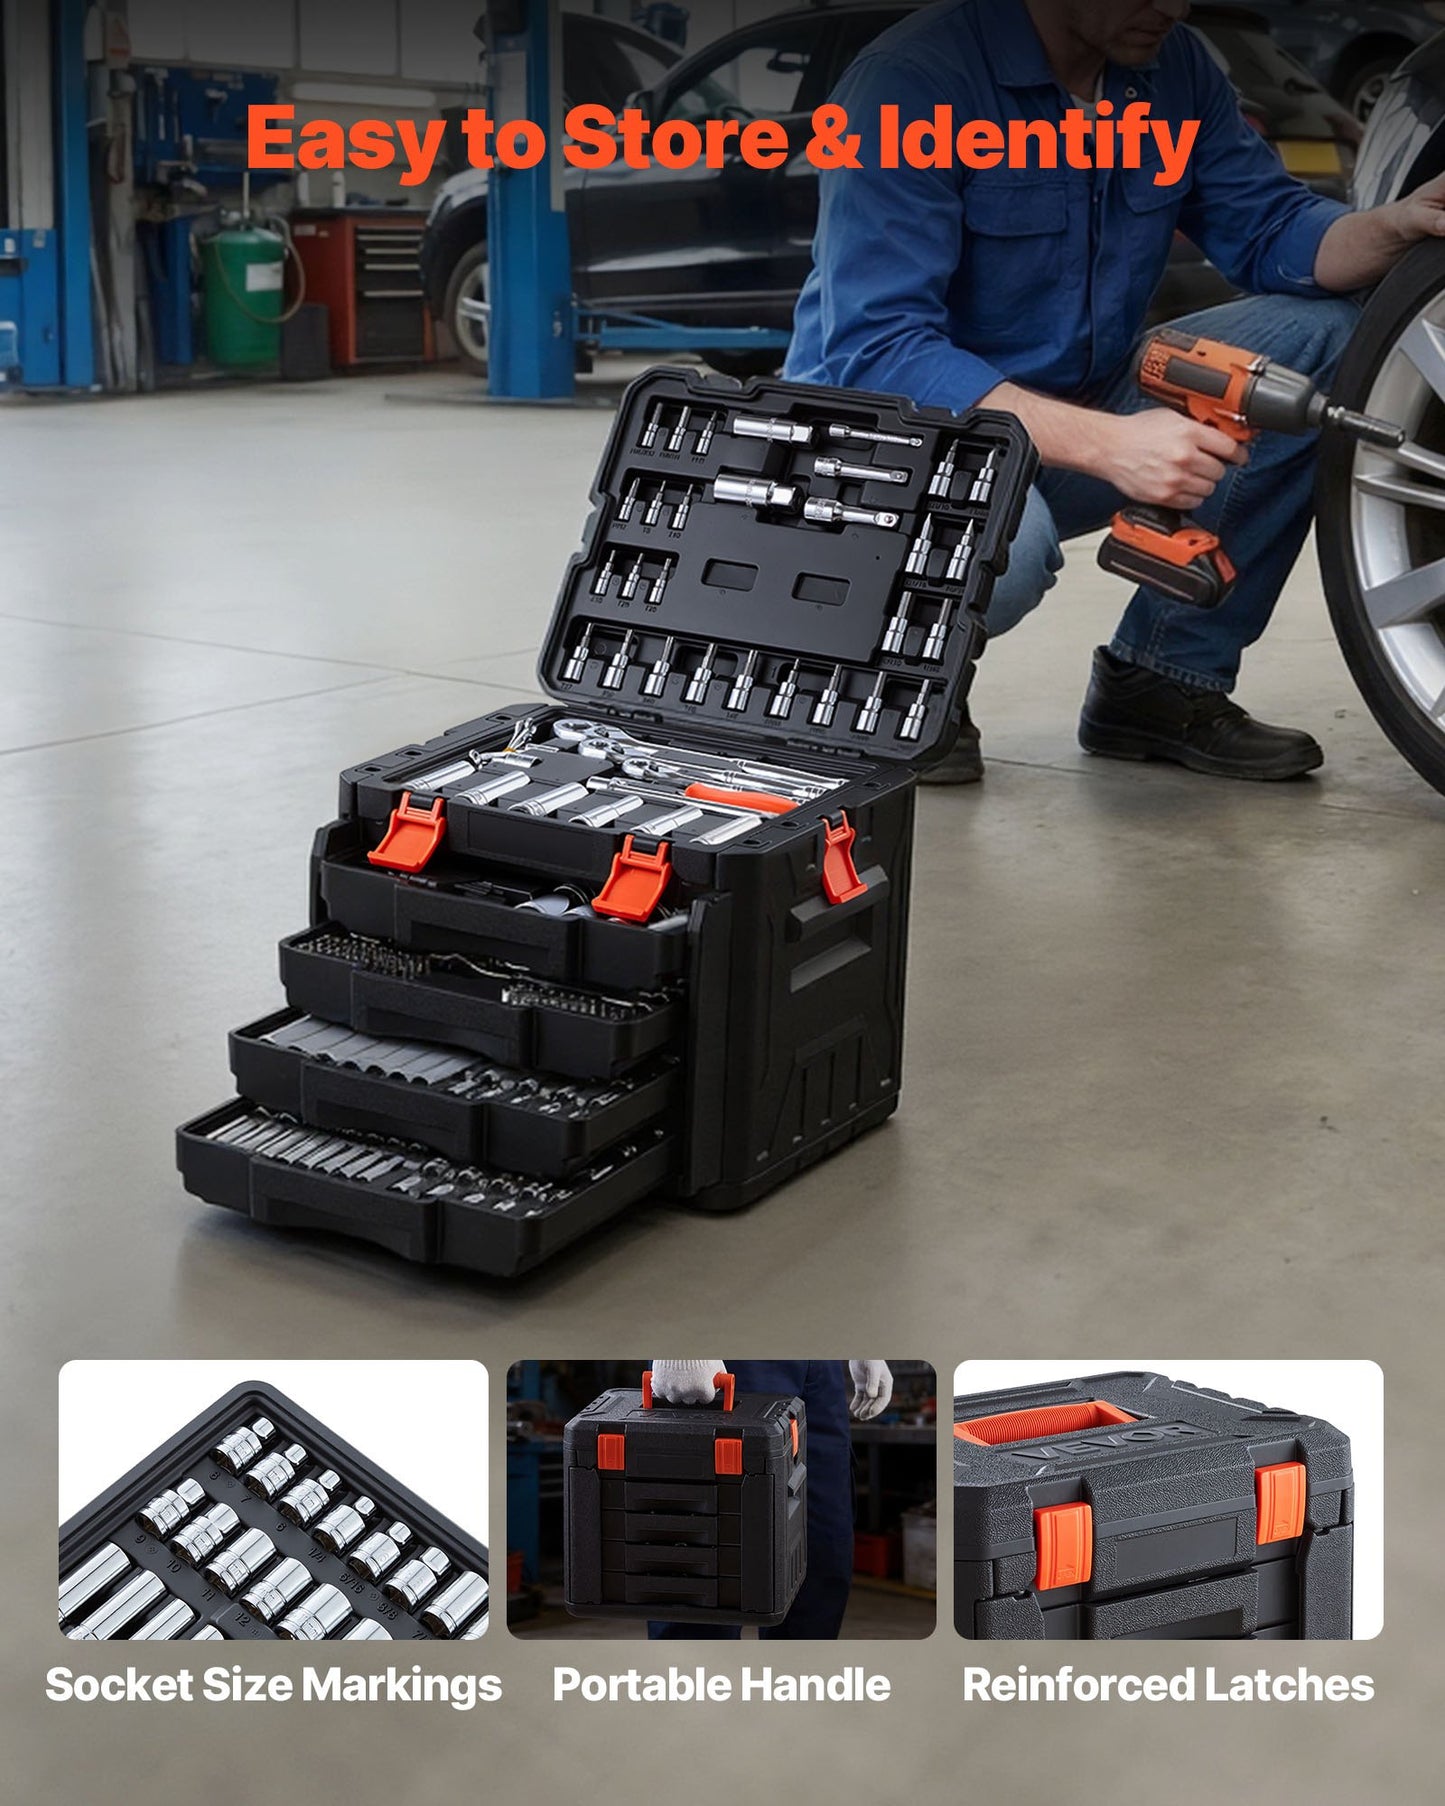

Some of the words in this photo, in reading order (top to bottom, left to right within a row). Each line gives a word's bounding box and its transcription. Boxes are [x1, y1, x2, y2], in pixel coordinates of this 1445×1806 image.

[1011, 1422, 1197, 1460] VEVOR
[134, 1534, 147, 1544] 9
[166, 1559, 182, 1573] 10
[202, 1588, 216, 1602] 11
[234, 1612, 250, 1627] 12
